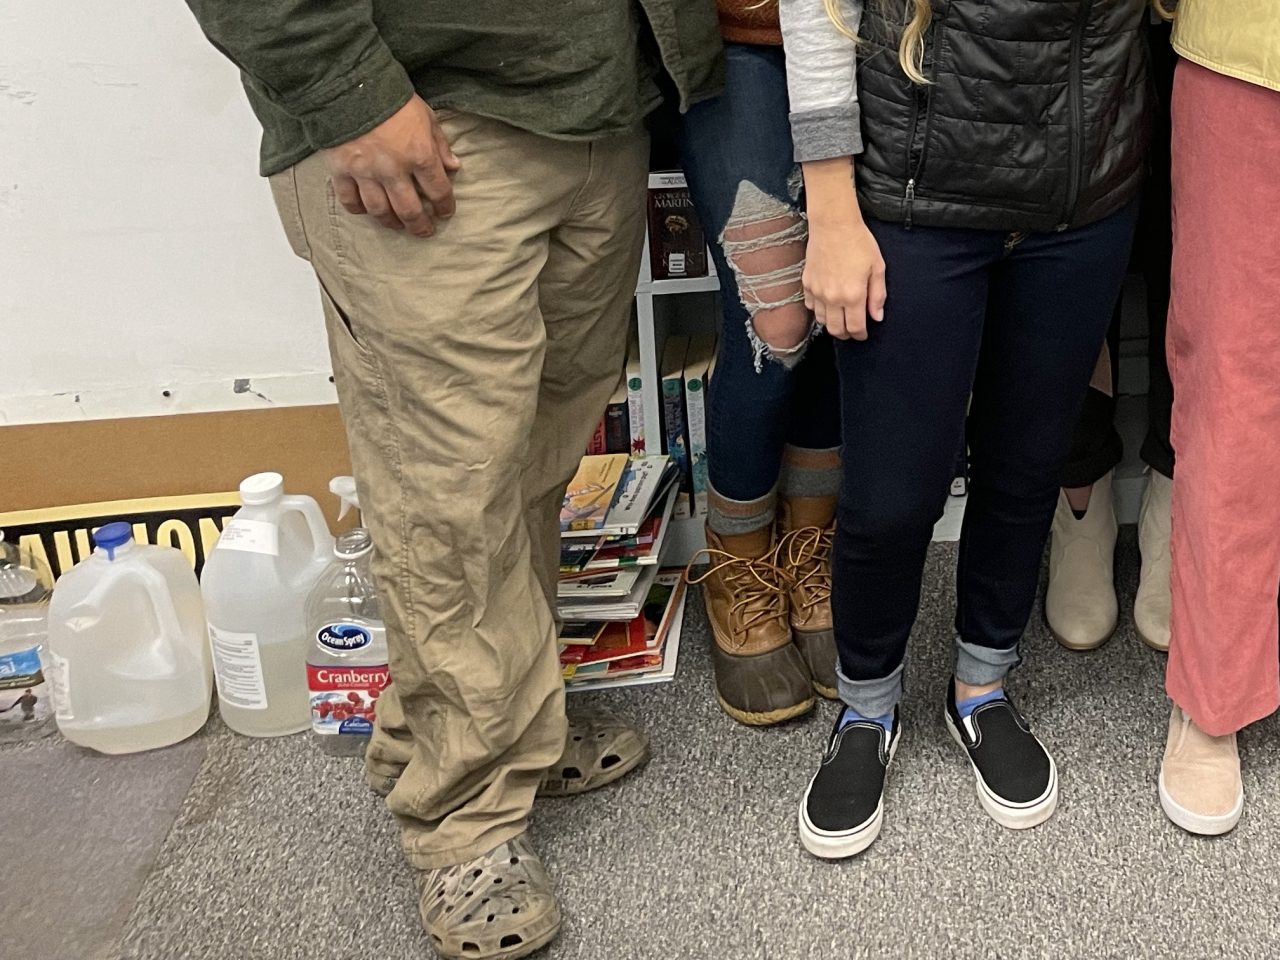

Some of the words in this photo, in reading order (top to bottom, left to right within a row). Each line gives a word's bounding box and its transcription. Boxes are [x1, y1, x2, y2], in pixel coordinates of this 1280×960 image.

[654, 199, 695, 208] MARTIN
[321, 632, 345, 646] Ocean
[344, 633, 366, 647] Spray
[317, 670, 391, 688] Cranberry
